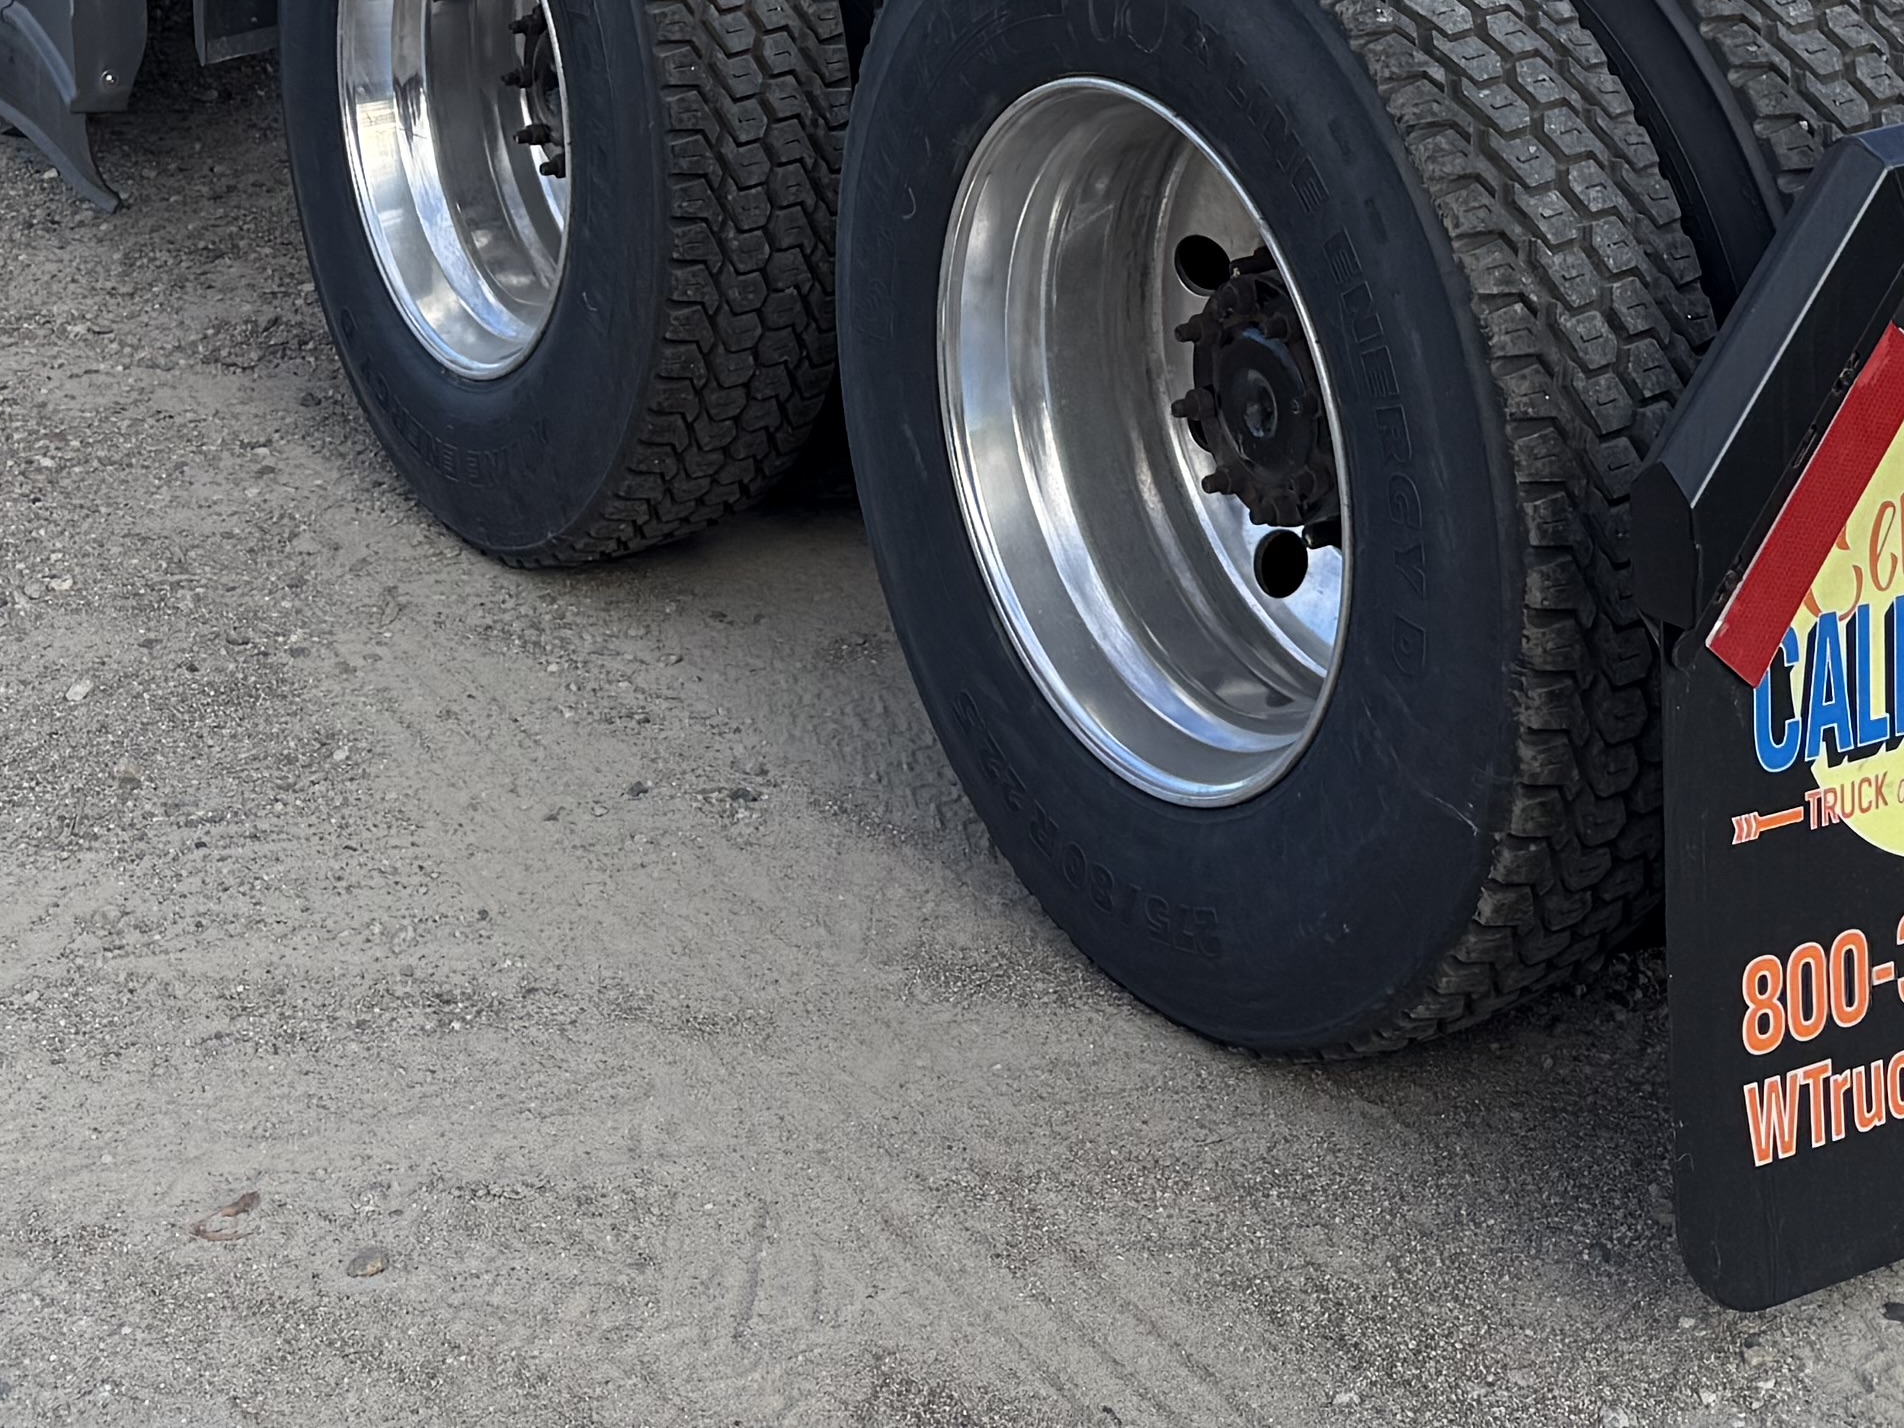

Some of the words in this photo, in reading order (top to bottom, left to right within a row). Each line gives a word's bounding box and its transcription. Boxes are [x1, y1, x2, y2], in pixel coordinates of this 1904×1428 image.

[1225, 52, 1331, 216] LINE
[1322, 224, 1428, 602] ENERGY
[1390, 609, 1429, 682] D
[1804, 771, 1889, 831] TRUCK
